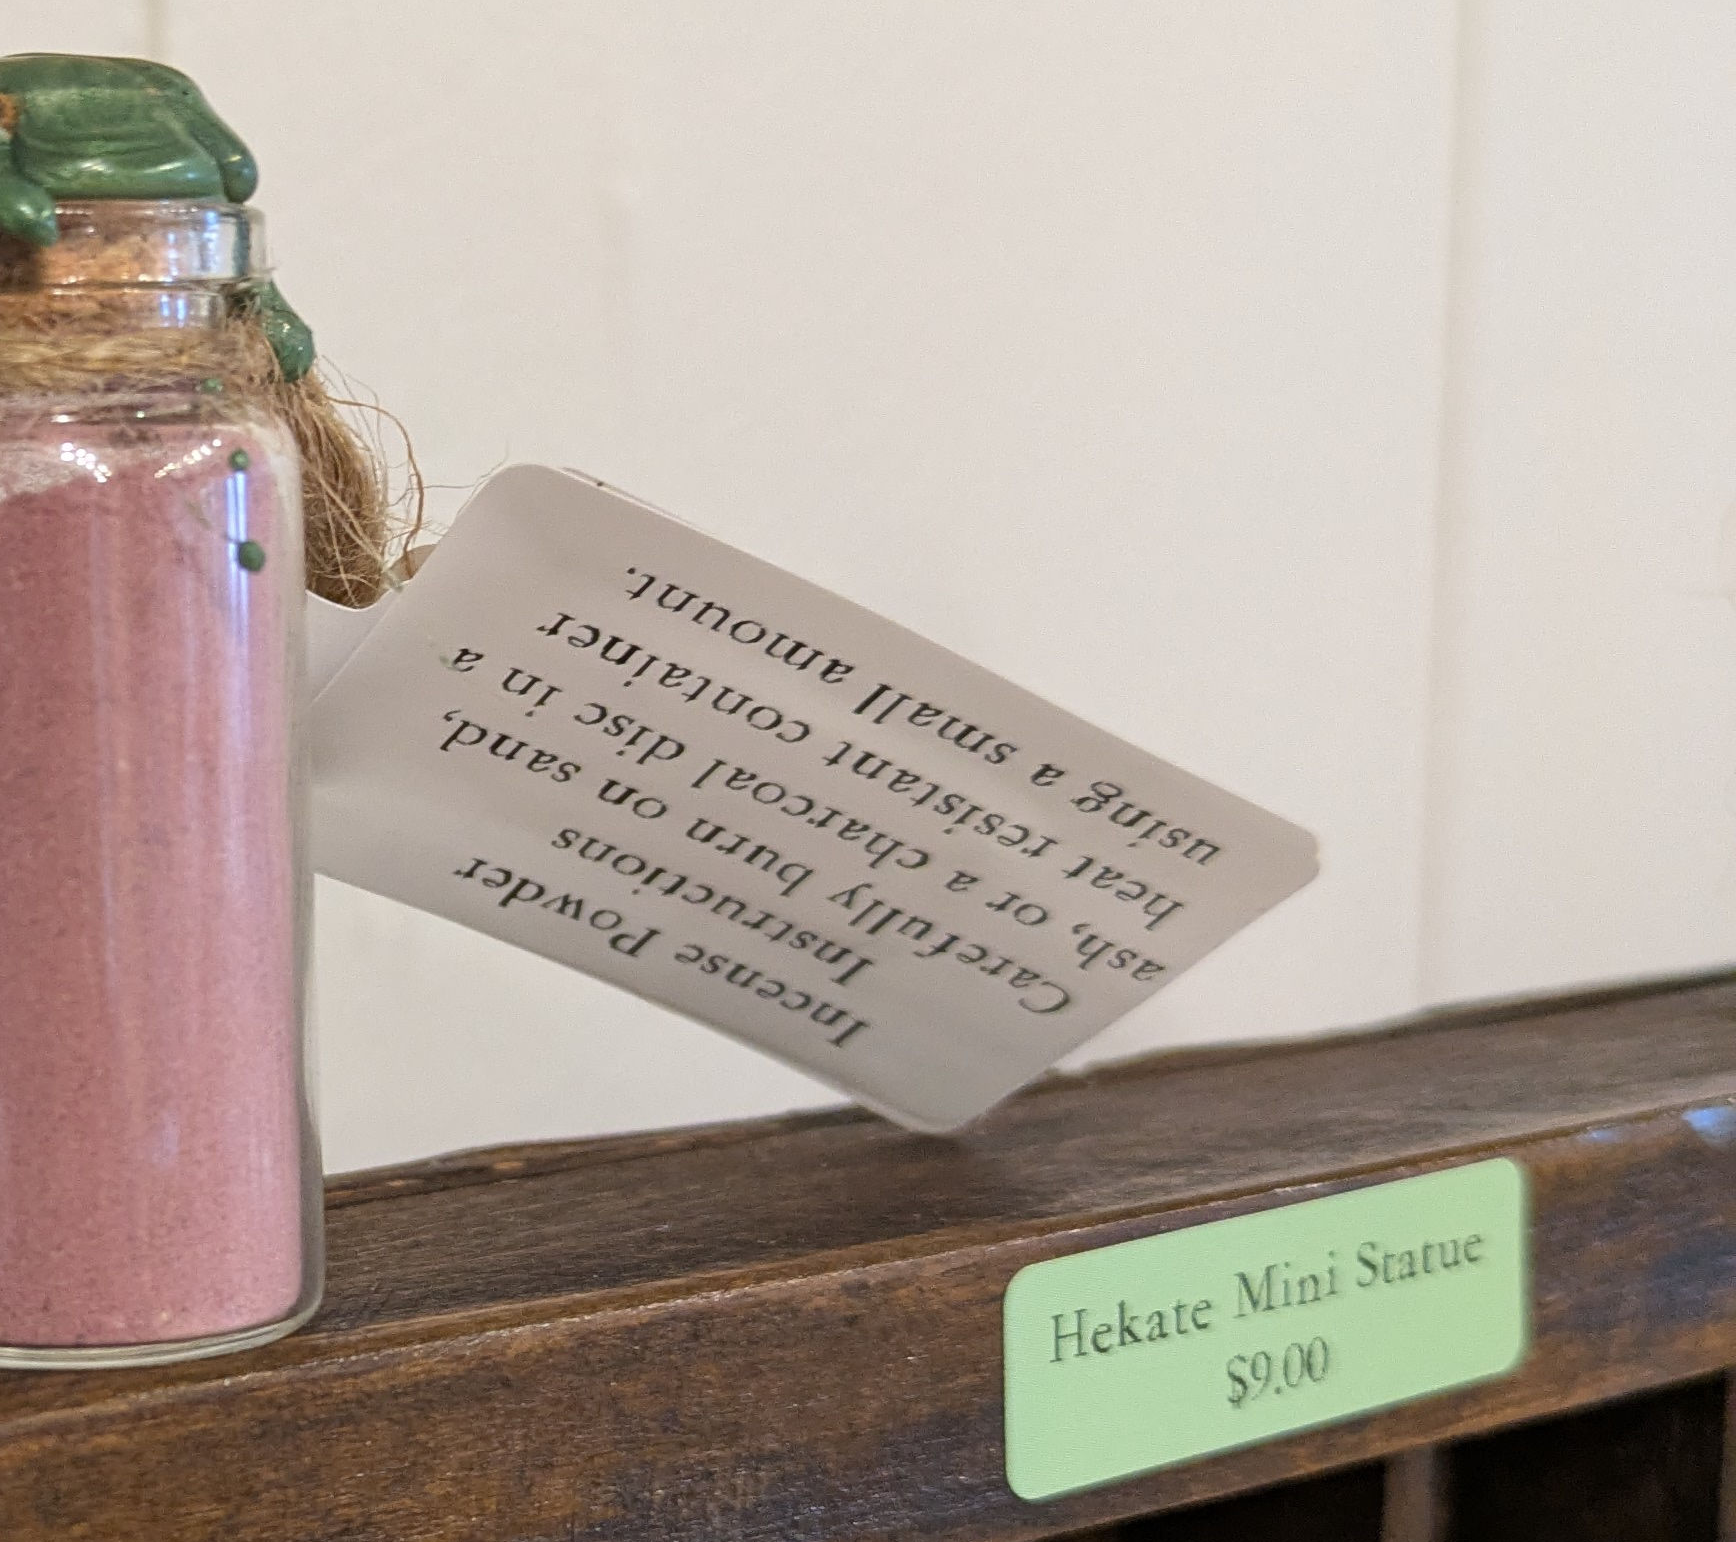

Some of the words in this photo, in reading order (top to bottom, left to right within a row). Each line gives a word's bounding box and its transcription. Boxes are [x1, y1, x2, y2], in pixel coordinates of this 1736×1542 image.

[448, 648, 485, 672] a
[626, 567, 856, 683] amount.
[502, 667, 563, 717] in
[536, 612, 811, 743] container
[440, 710, 582, 782] sand,
[573, 703, 686, 765] disc
[852, 683, 1020, 764] small
[598, 779, 669, 819] on
[691, 759, 931, 869] charcoal
[822, 741, 1059, 857] resistant
[1030, 763, 1066, 786] a
[686, 818, 814, 897] burn
[1070, 781, 1222, 865] using
[452, 858, 661, 958] Powder
[551, 828, 874, 986] Instructions
[945, 870, 982, 892] a
[985, 892, 1050, 926] or
[1062, 856, 1184, 931] heat
[827, 883, 1073, 1014] Carefully
[1072, 924, 1168, 982] ash,
[674, 944, 870, 1048] Incense
[1050, 1298, 1212, 1363] Hekate
[1233, 1250, 1339, 1319] Mini
[1356, 1232, 1485, 1291] Statue
[1226, 1336, 1330, 1410] $9.00
